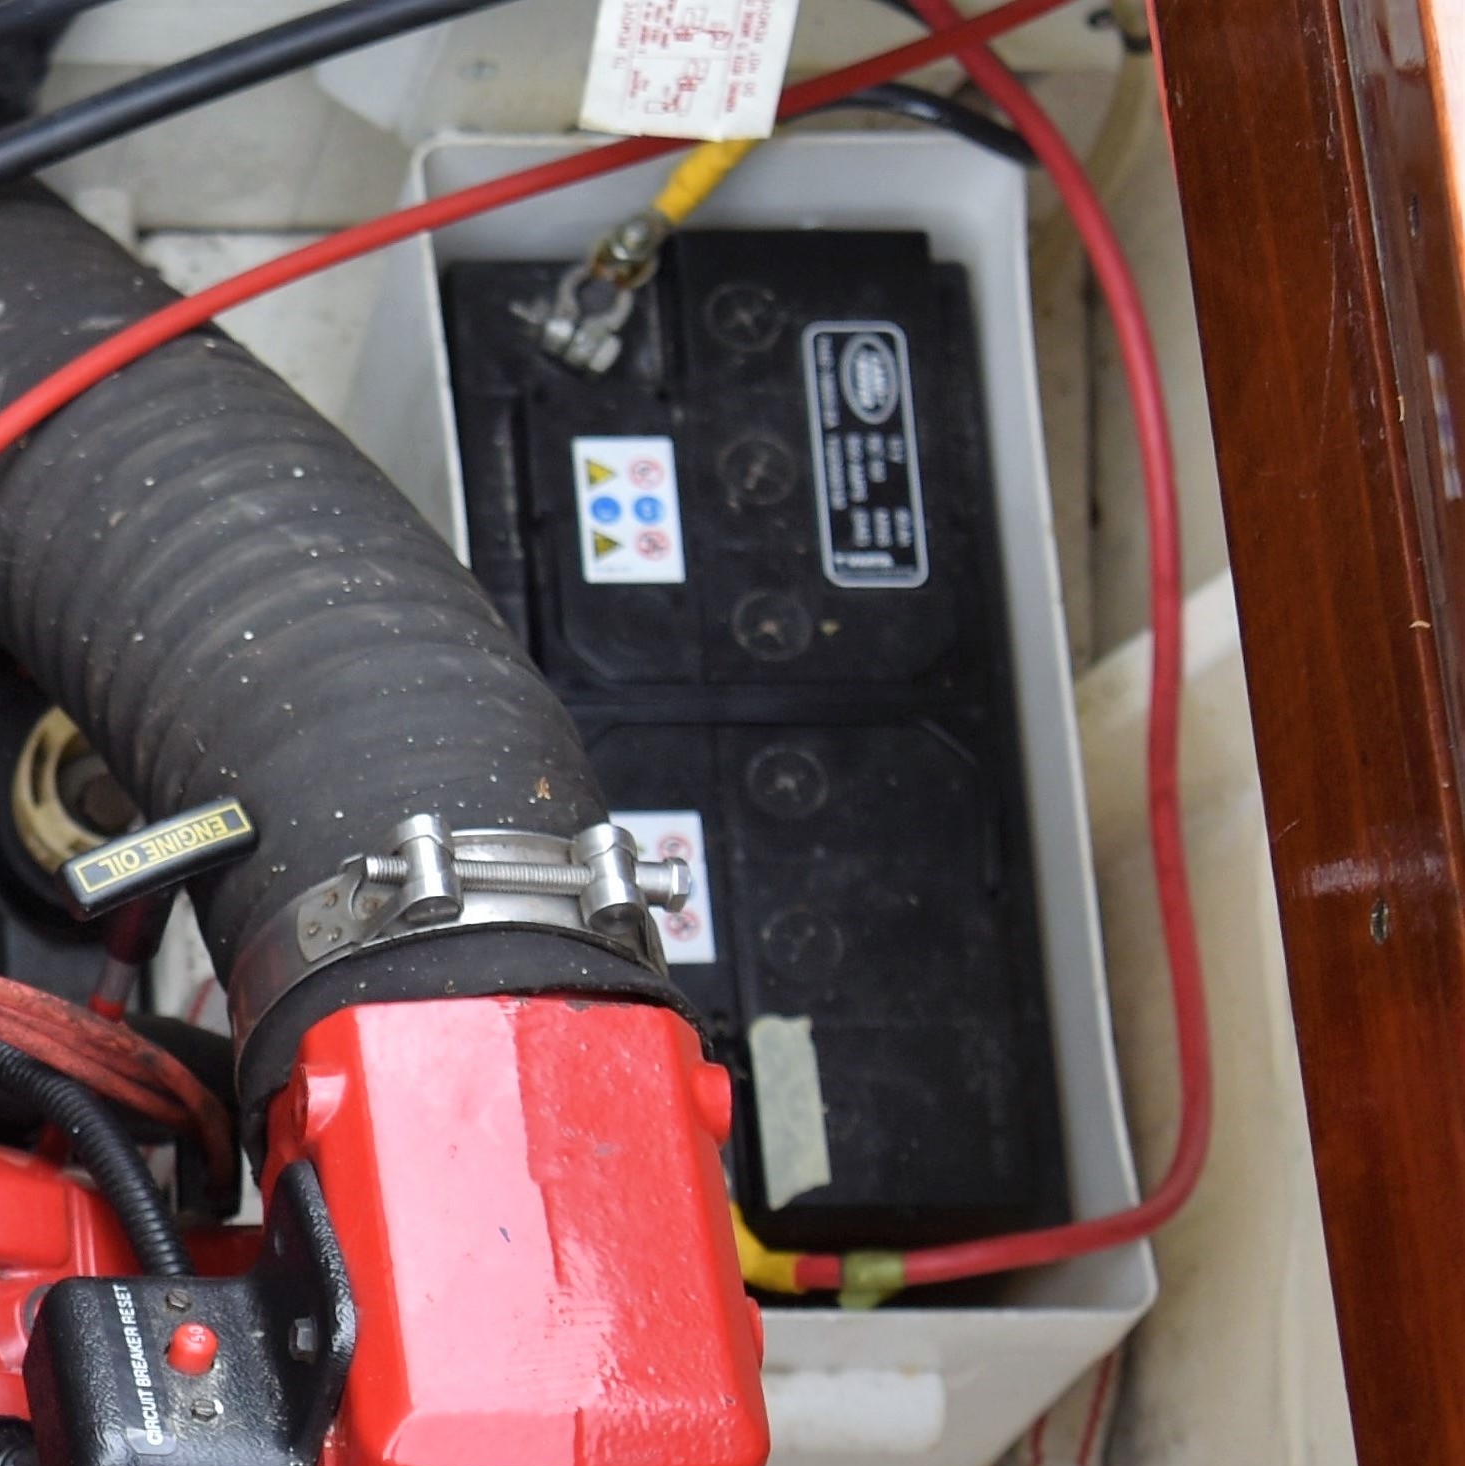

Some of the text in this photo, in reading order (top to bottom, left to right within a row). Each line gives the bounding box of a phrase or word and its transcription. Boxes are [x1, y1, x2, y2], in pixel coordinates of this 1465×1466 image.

[97, 814, 229, 878] ENGINE OIL
[112, 1283, 165, 1446] CIRCUIT BREAKER RESET
